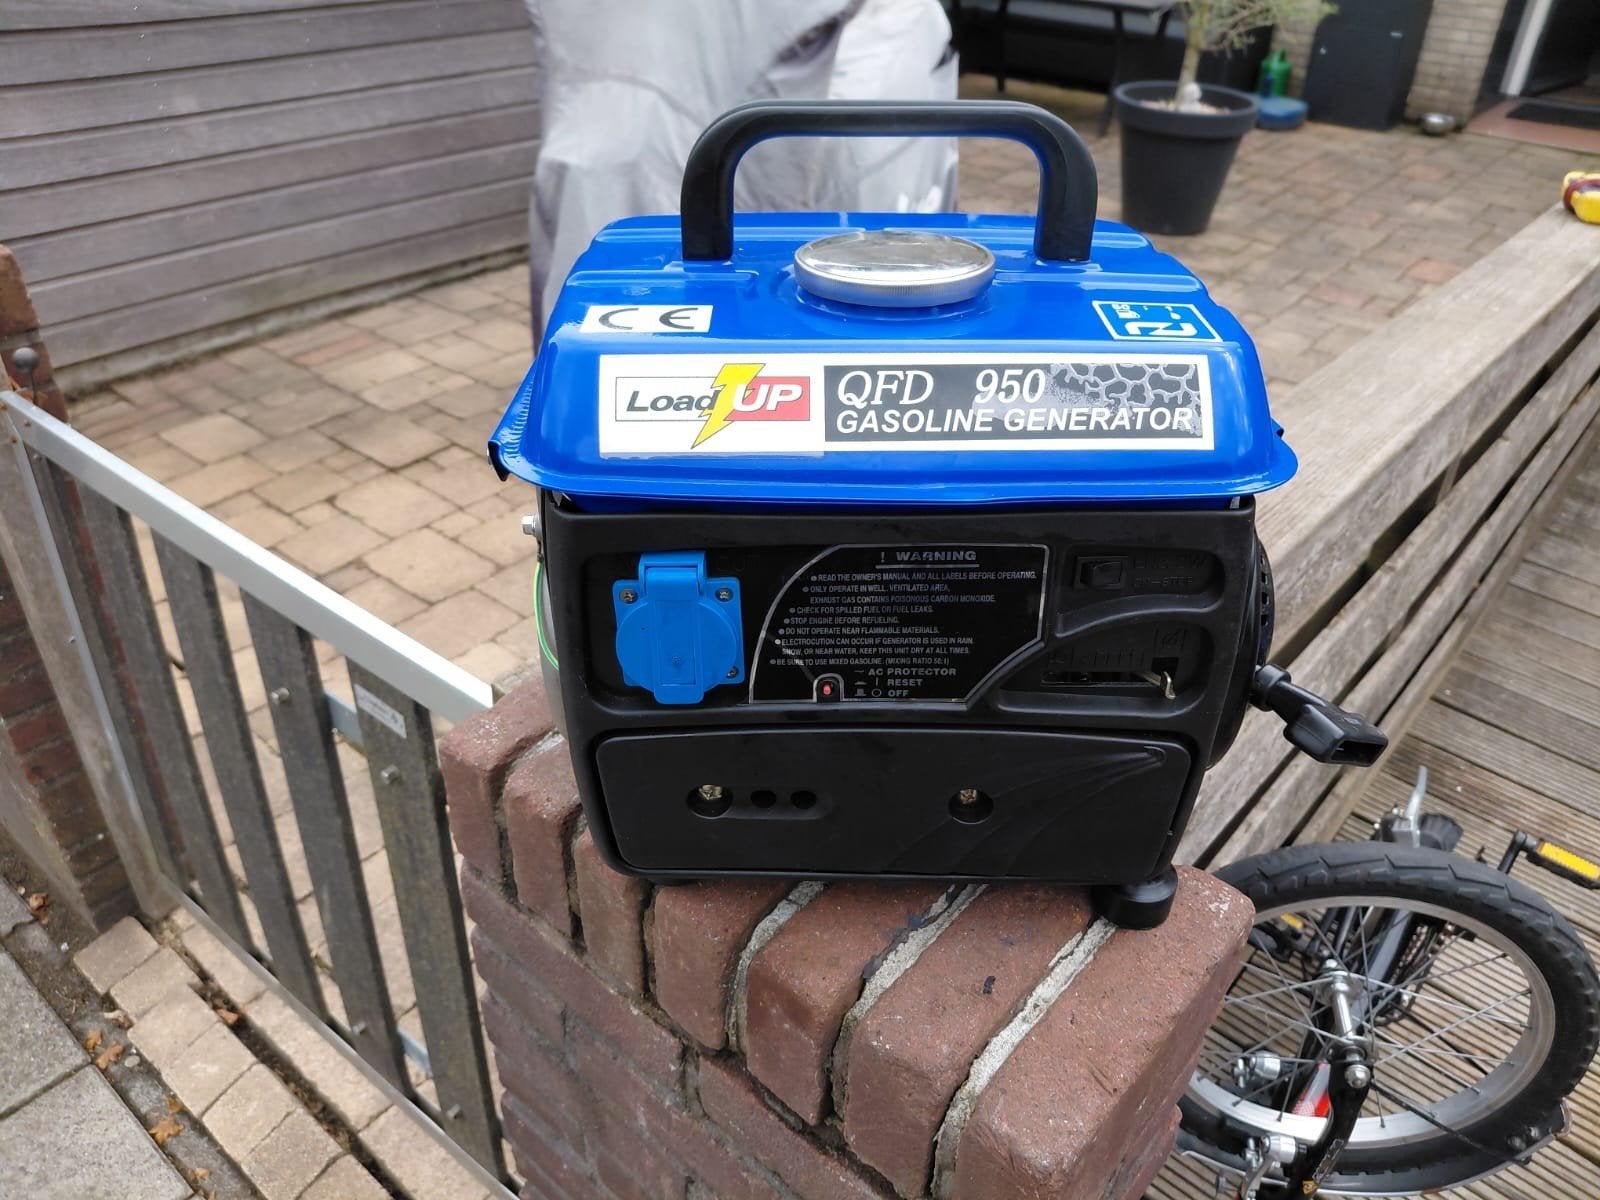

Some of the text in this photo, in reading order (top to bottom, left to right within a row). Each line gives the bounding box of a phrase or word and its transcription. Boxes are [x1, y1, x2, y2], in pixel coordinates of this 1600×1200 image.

[598, 306, 699, 331] CE
[837, 369, 1047, 409] QFD 950
[626, 383, 803, 412] Load UP
[836, 406, 1194, 434] GASOLINE GENERATOR
[895, 550, 977, 562] WARNING
[818, 571, 1036, 582] READ THE OWNER'S MANUAL AND ALL LABELS BEFORE OPERATING.
[810, 584, 827, 592] ONLY
[828, 584, 859, 592] OPERATE
[860, 584, 867, 592] IN
[888, 583, 929, 592] VENTILATED
[810, 596, 840, 604] EXHAUST
[841, 596, 856, 604] GAS
[856, 595, 889, 604] CONTAINS
[890, 595, 928, 604] POISONOUS
[930, 595, 958, 603] CARBON
[796, 606, 820, 614] CHECK
[820, 606, 834, 614] FOR
[835, 606, 862, 614] SPILLED
[863, 606, 880, 614] FUEL
[892, 605, 910, 613] FUEL
[834, 616, 860, 624] BEFORE
[796, 627, 810, 635] NOT
[810, 627, 840, 635] OPERATE
[882, 637, 920, 645] GENERATOR
[922, 637, 928, 645] IS
[930, 637, 948, 645] USED
[948, 637, 956, 645] IN
[859, 647, 878, 655] KEEP
[878, 647, 892, 655] THIS
[776, 658, 786, 666] BE
[787, 658, 804, 666] SURE
[804, 658, 814, 666] TO
[814, 658, 828, 666] USE
[828, 658, 849, 666] MIXED
[886, 657, 910, 665] (MIXING
[912, 657, 932, 665] RATIO
[867, 667, 957, 677] AC PROTECTOR
[886, 678, 924, 687] RESET
[886, 689, 909, 698] OFF
